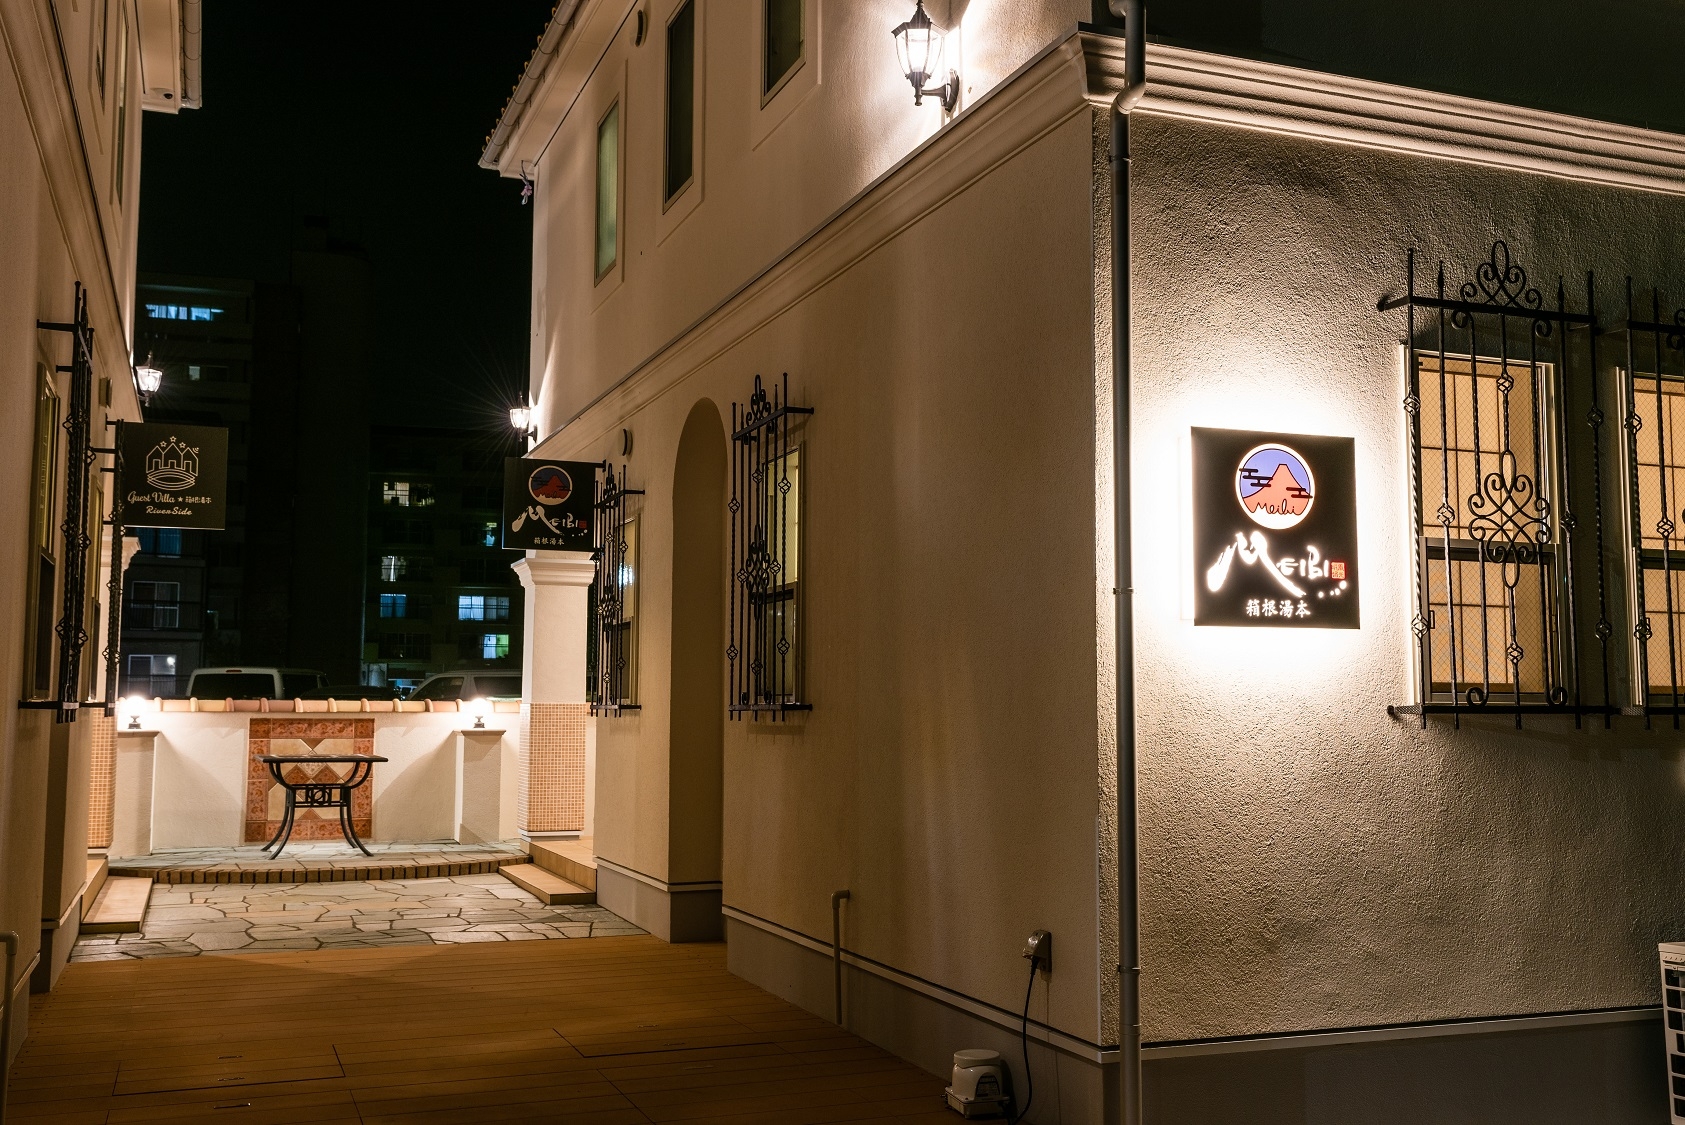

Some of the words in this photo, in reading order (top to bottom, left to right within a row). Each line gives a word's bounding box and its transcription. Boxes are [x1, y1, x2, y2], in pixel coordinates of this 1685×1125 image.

[127, 491, 151, 504] Guest
[152, 491, 175, 503] Villa
[1246, 598, 1311, 618] 箱根湯本
